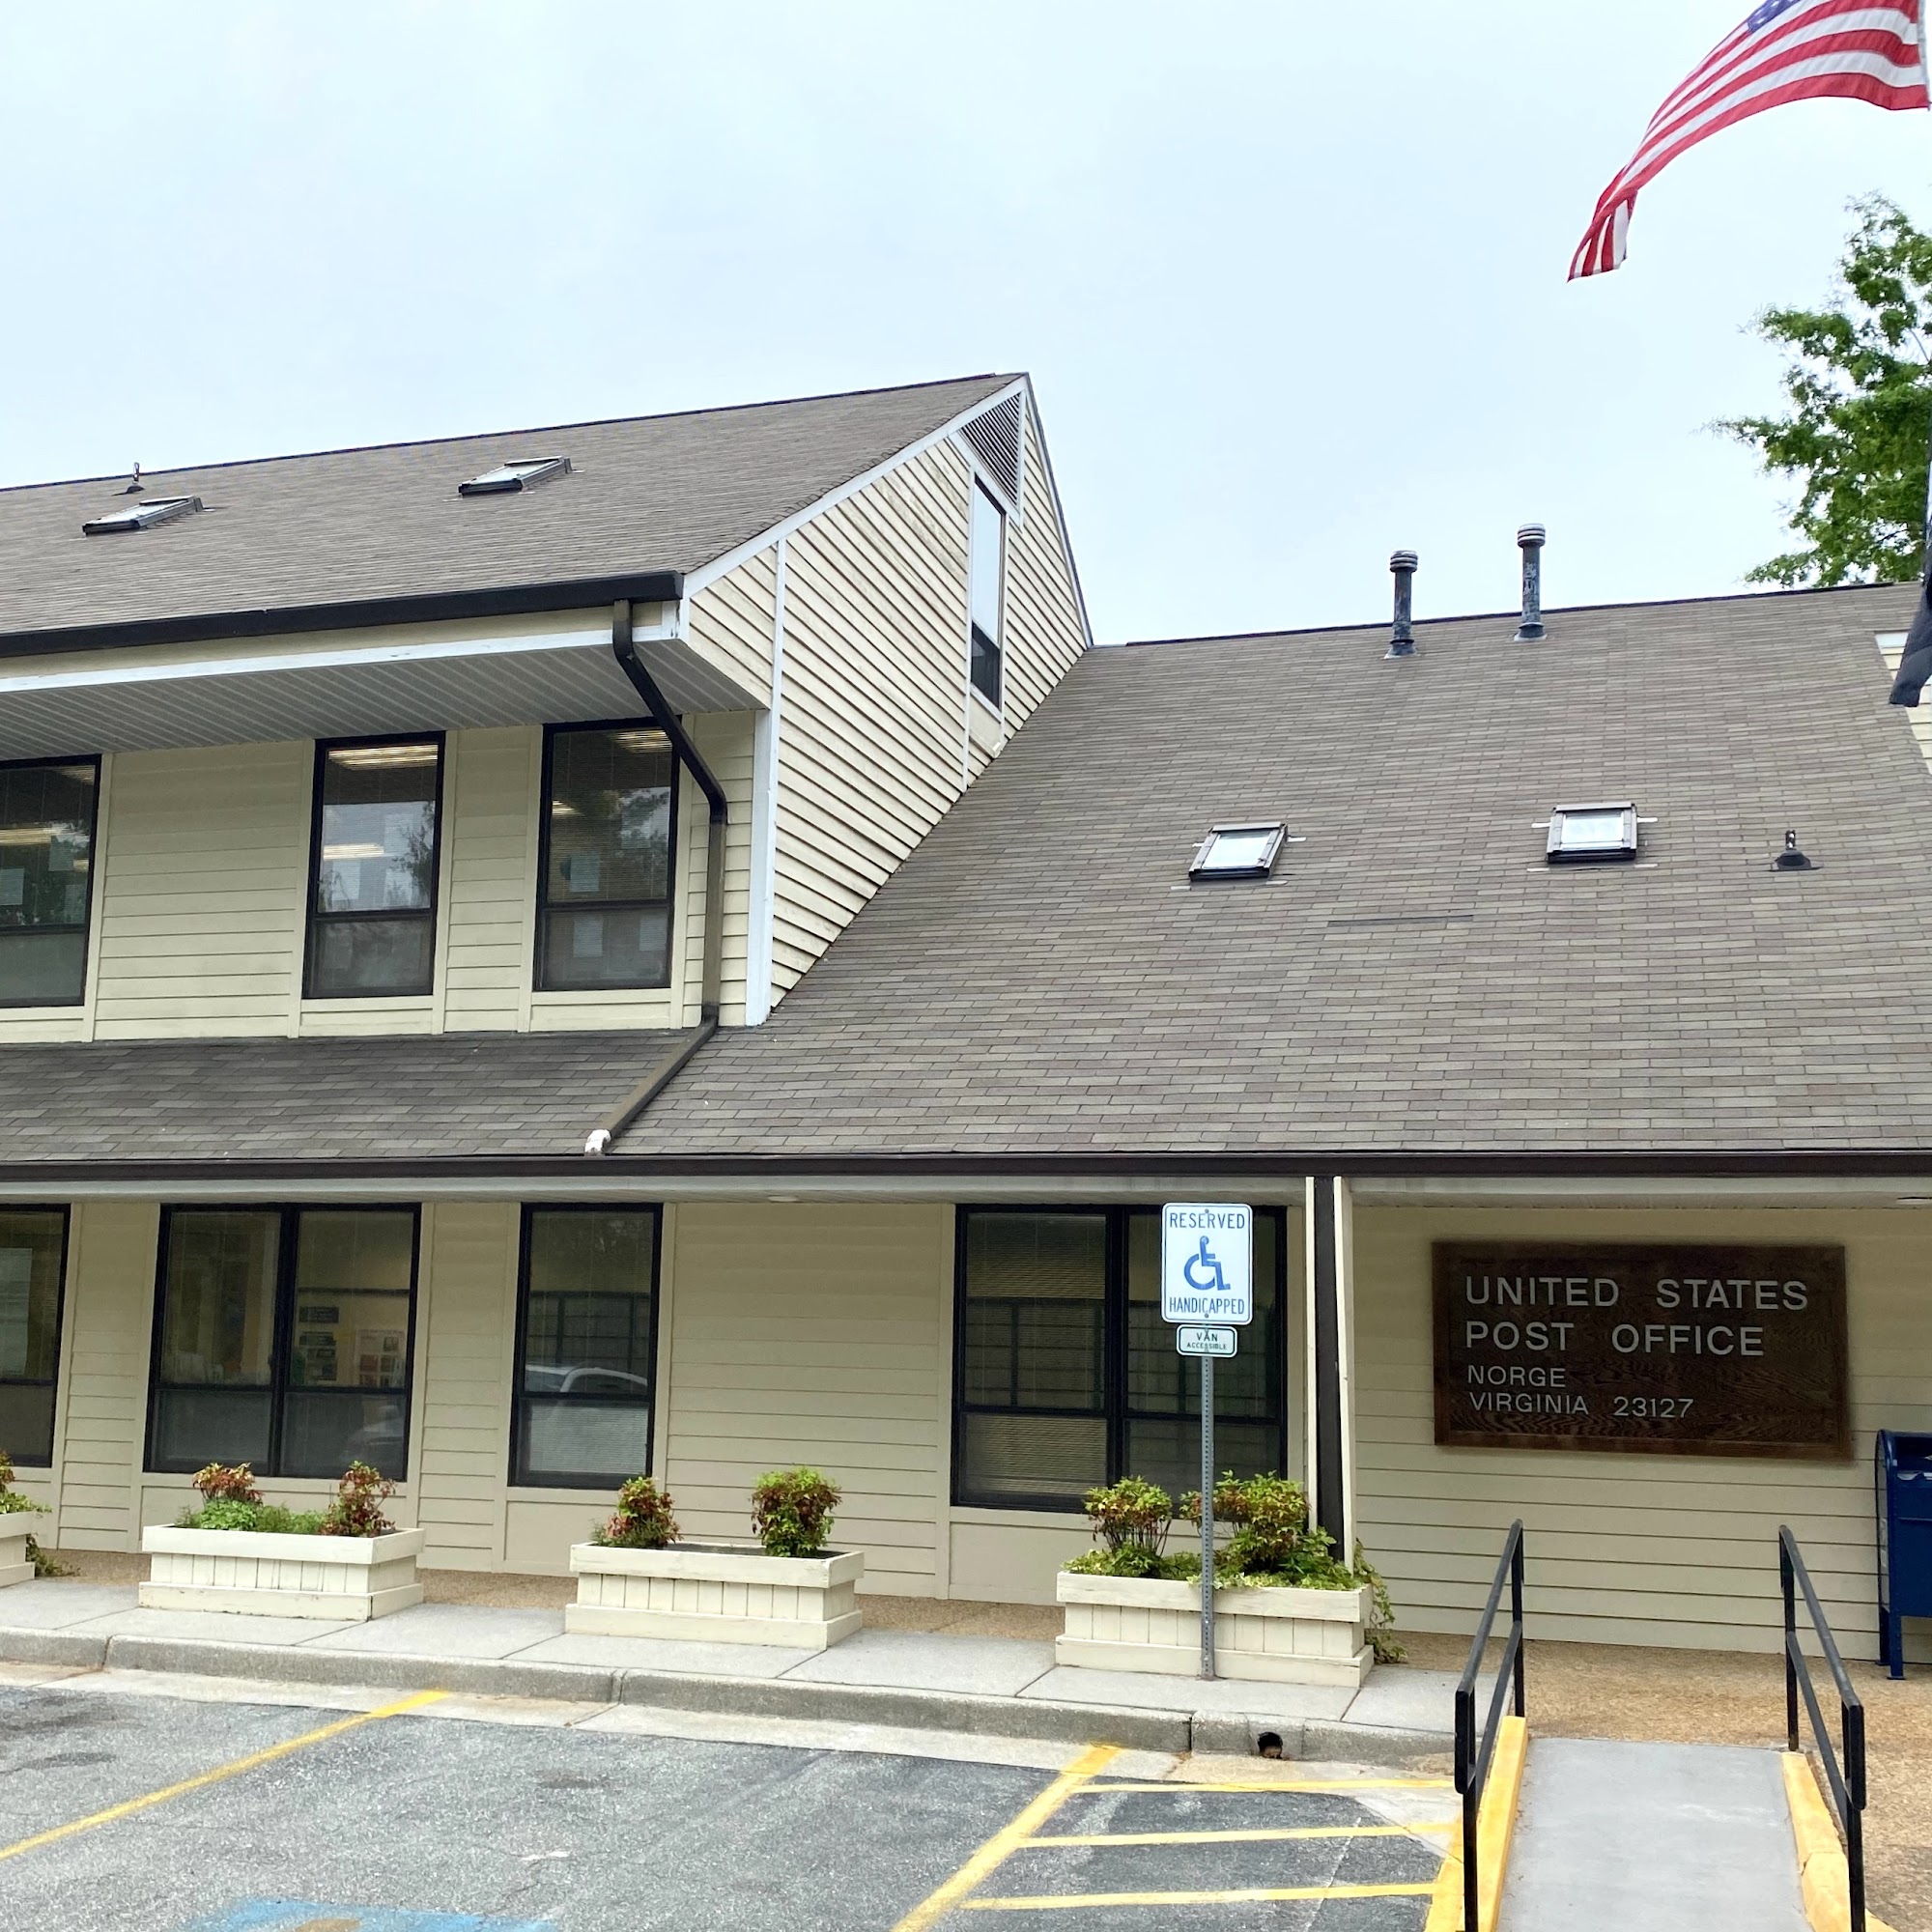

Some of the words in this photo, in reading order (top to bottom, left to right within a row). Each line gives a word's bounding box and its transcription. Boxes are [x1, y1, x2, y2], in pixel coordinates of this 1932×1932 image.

[1169, 1212, 1245, 1229] RESERVED
[1465, 1276, 1620, 1308] UNITED
[1656, 1279, 1808, 1311] STATES
[1169, 1296, 1245, 1315] HANDICAPPED
[1186, 1342, 1228, 1350] ACCESSIBLE
[1196, 1332, 1218, 1342] VAN
[1465, 1321, 1575, 1350] POST
[1611, 1323, 1765, 1356] OFFICE
[1467, 1365, 1566, 1388] NORGE
[1469, 1392, 1590, 1416] VIRGINIA
[1613, 1396, 1694, 1419] 23127
